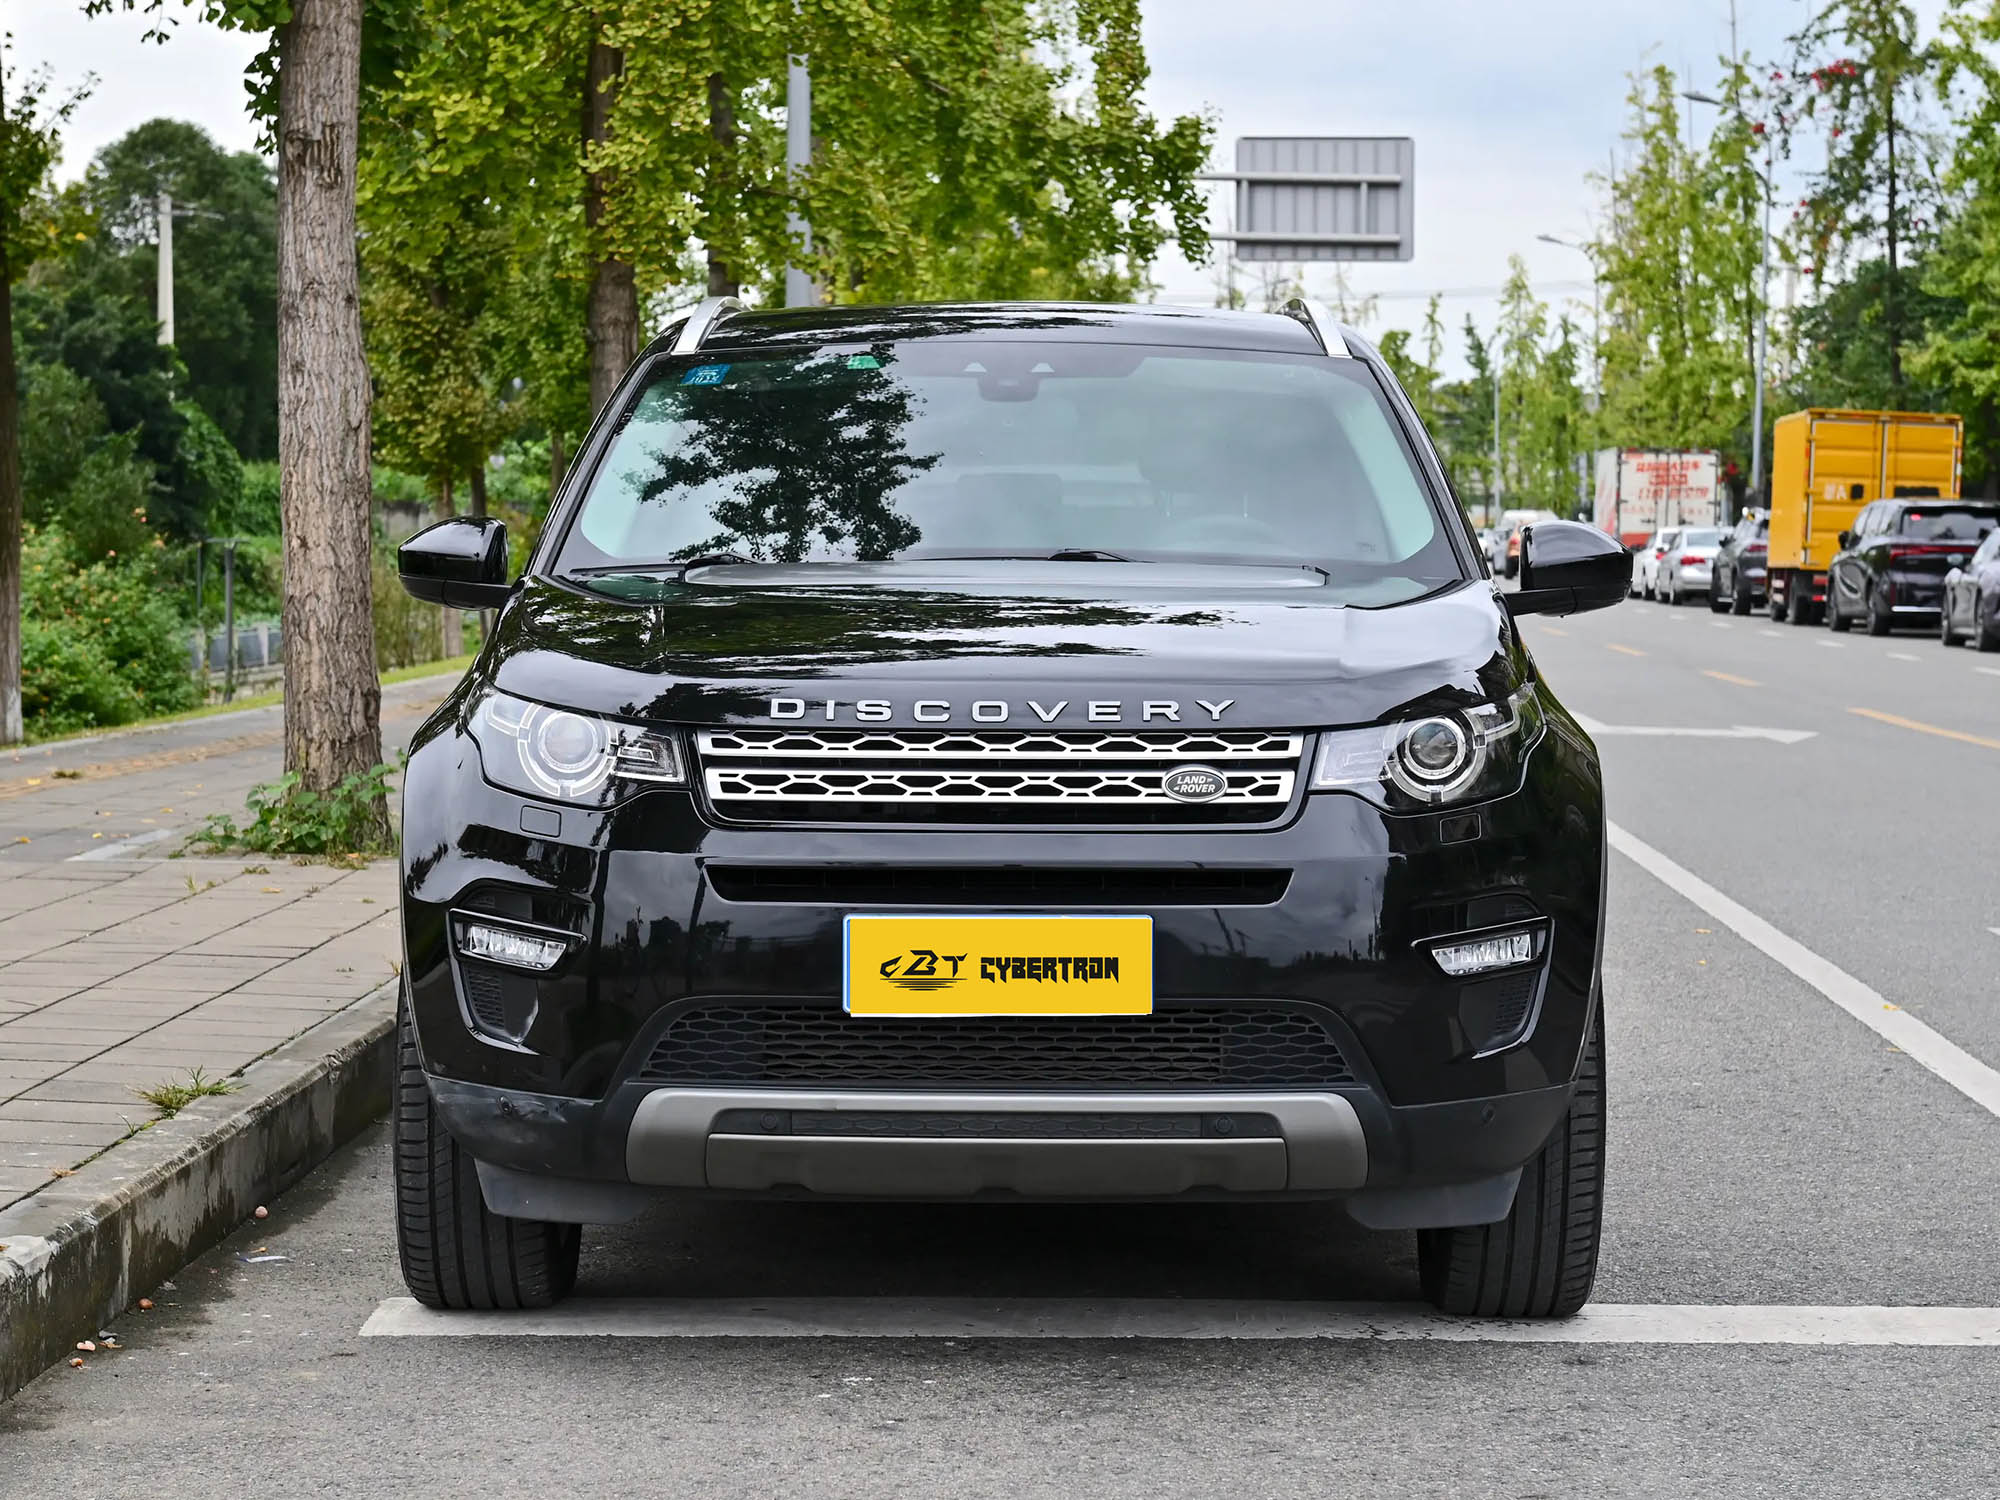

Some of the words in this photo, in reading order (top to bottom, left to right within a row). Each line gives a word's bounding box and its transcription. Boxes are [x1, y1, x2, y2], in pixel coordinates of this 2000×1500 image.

[769, 698, 1235, 722] DISCOVERY
[1177, 775, 1207, 784] LAND
[1180, 784, 1216, 793] ROVER
